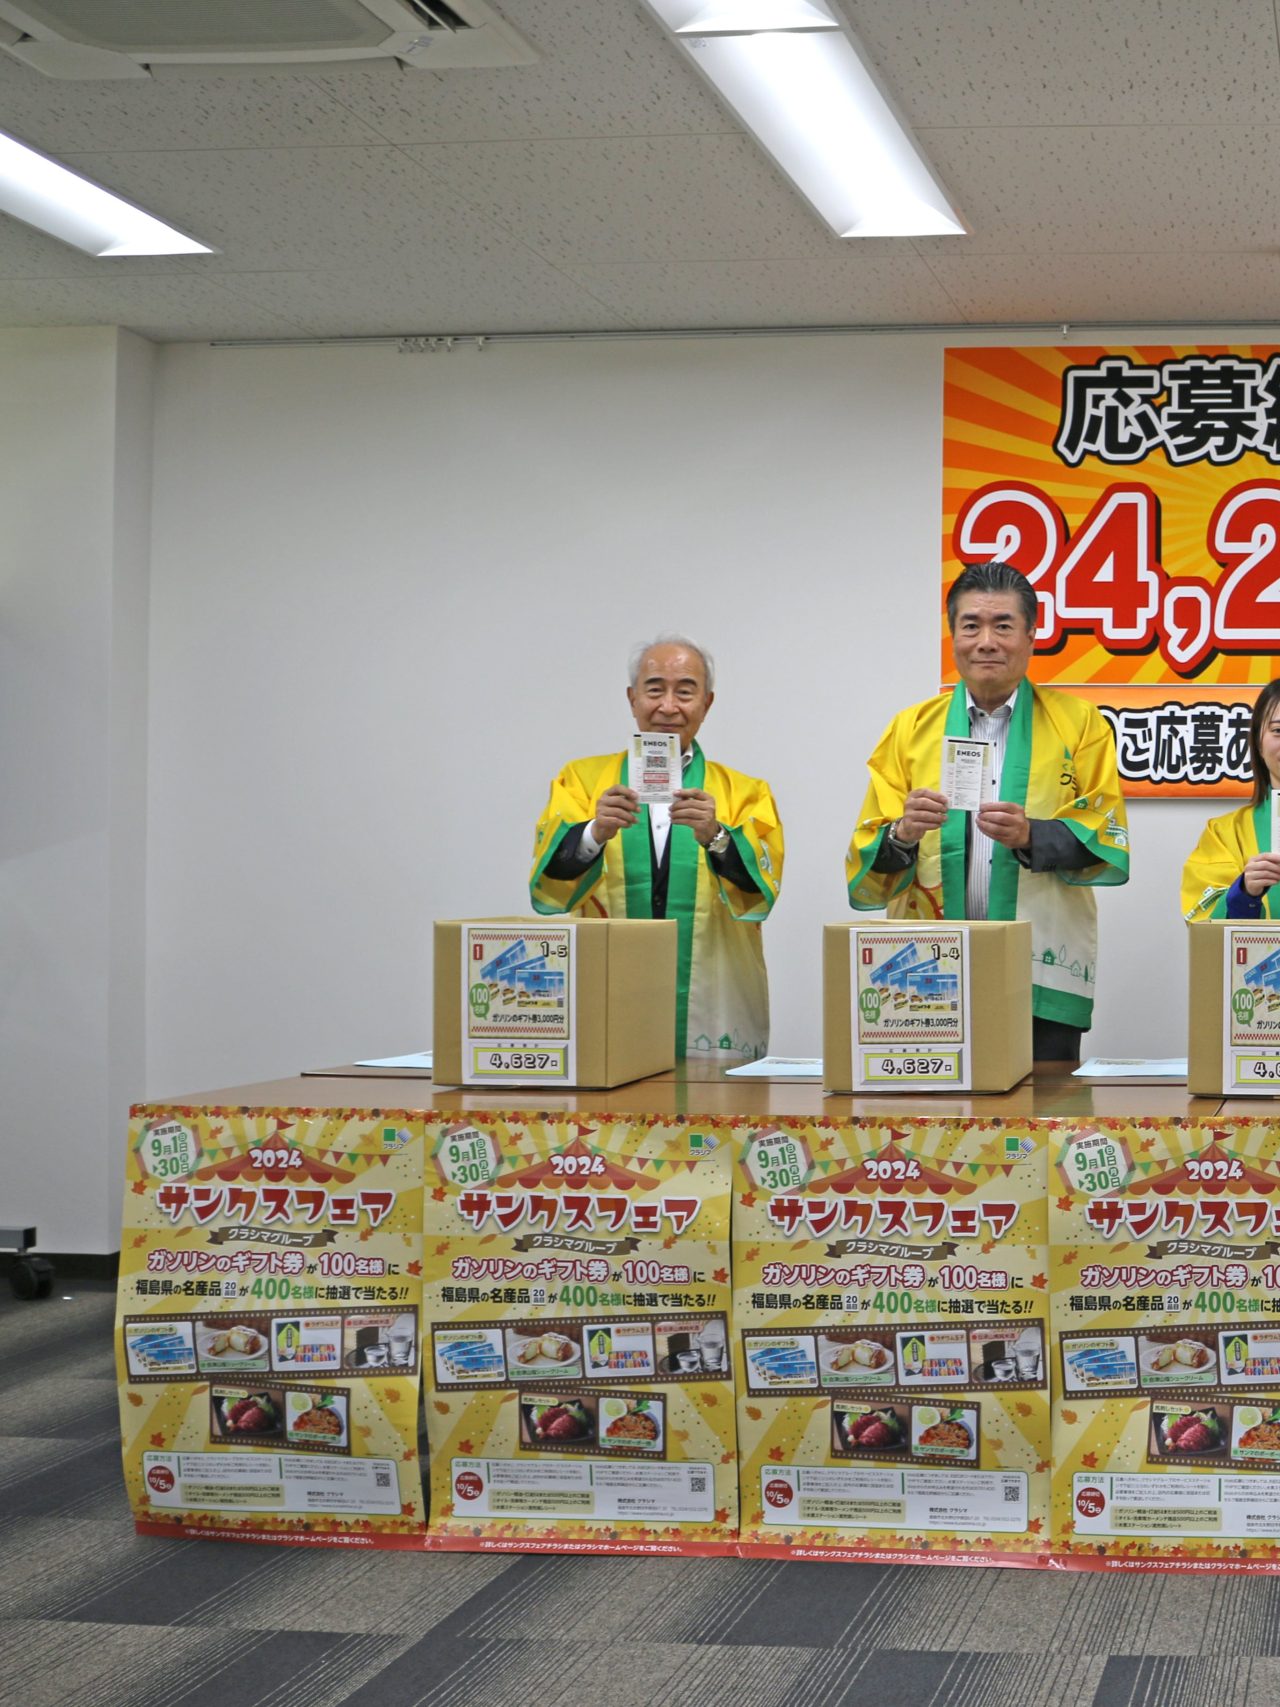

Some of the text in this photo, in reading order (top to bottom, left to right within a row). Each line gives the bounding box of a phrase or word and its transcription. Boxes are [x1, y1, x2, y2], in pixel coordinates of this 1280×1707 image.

[956, 750, 981, 758] ENEOS
[540, 942, 568, 957] 1-5
[932, 944, 960, 960] 1-4
[472, 990, 488, 1002] 100
[862, 994, 879, 1008] 100
[1235, 994, 1253, 1009] 100
[249, 1148, 303, 1169] 2024
[550, 1154, 605, 1176] 2024
[863, 1159, 920, 1180] 2024
[1185, 1159, 1243, 1181] 2024
[156, 1183, 397, 1225] サンクスフェア
[456, 1191, 700, 1233] サンクスフェア
[767, 1198, 1019, 1238] サンクスフェア
[229, 1229, 314, 1246] クラシマグループ
[533, 1237, 617, 1253] クラシマグループ
[846, 1242, 934, 1259] クラシマグループ
[1167, 1242, 1257, 1259] クラシマグループ
